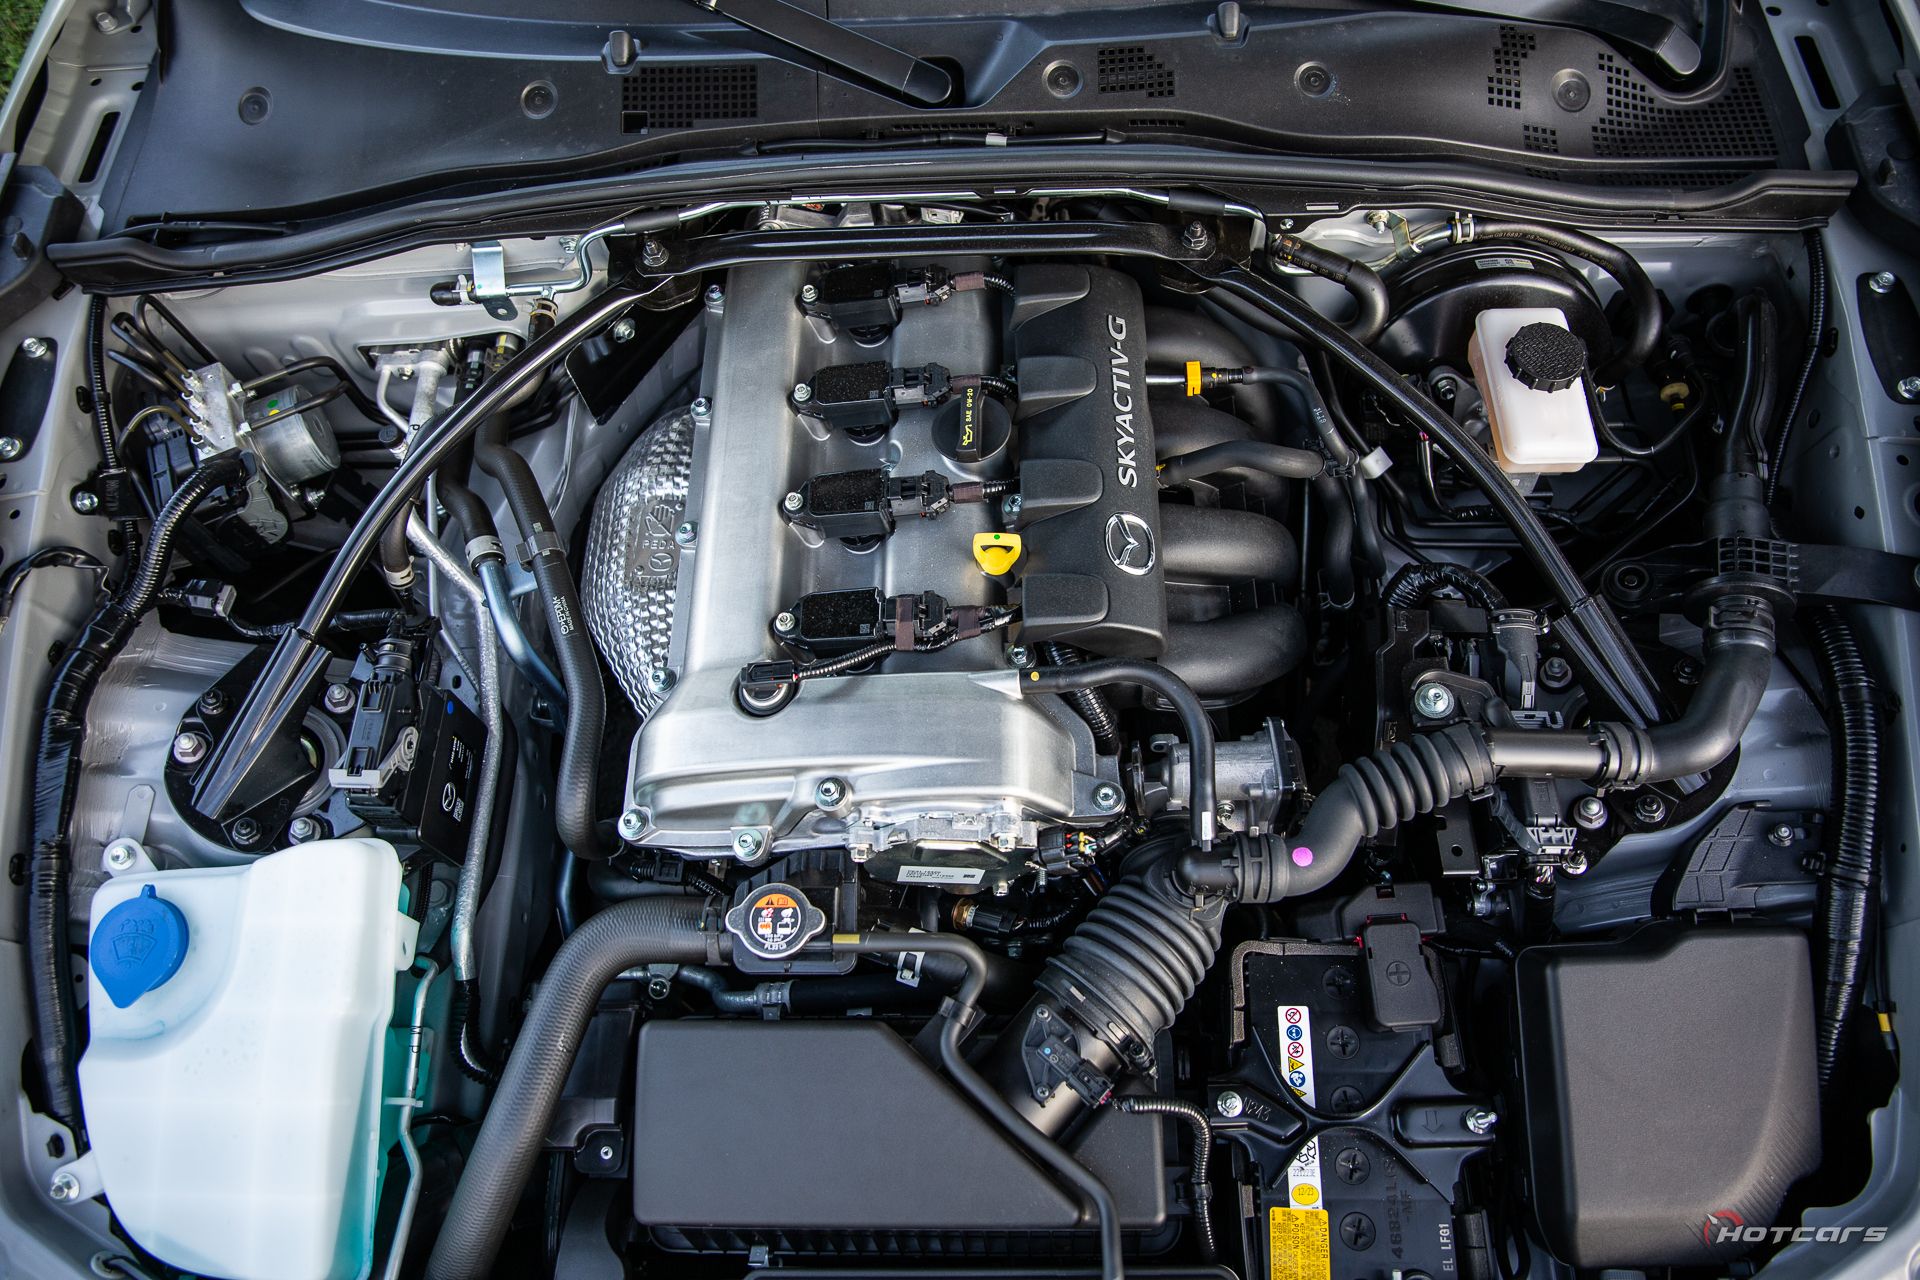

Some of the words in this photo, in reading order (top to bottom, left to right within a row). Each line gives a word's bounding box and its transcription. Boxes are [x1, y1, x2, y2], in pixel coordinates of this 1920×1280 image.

[1108, 314, 1138, 489] SKYACTIV-G
[1291, 1223, 1300, 1249] POISON
[1320, 1228, 1329, 1259] DANGER
